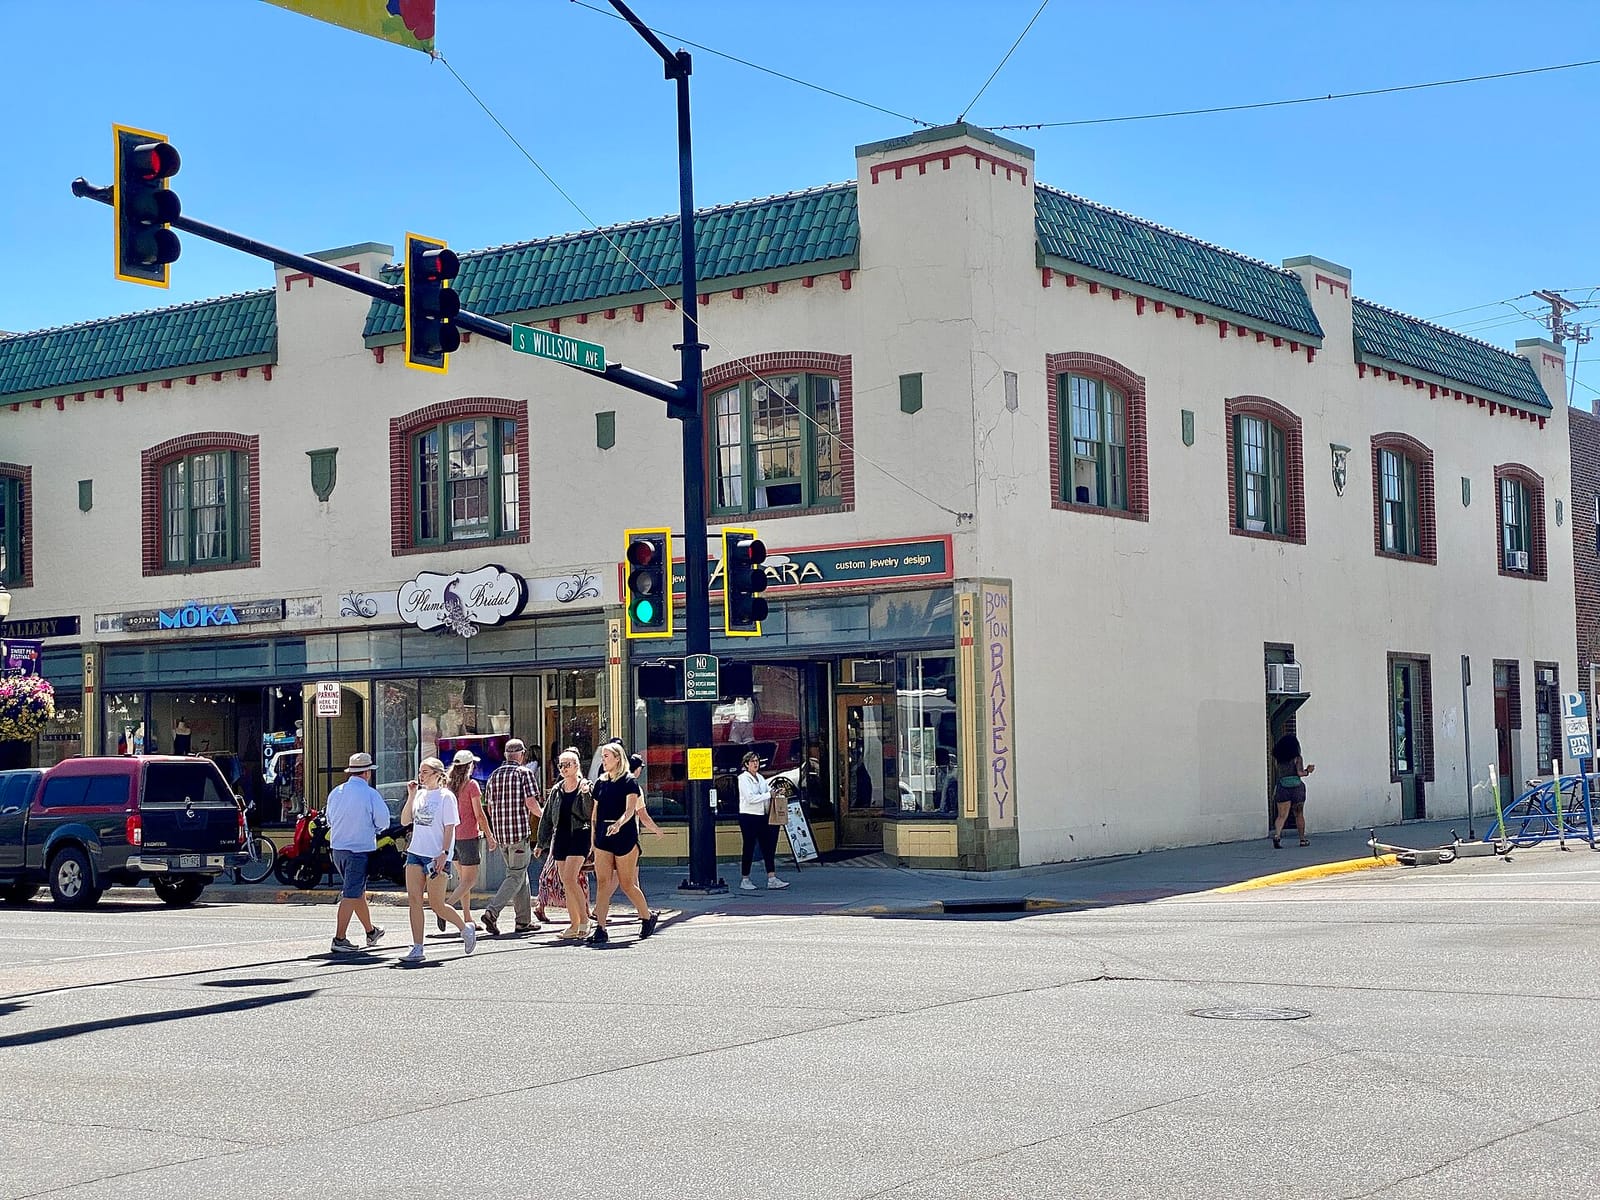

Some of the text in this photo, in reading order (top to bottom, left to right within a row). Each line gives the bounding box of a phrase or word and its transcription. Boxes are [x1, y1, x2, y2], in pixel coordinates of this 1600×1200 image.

[520, 333, 598, 367] S WILLSON AVE
[835, 561, 866, 570] custom
[870, 557, 899, 569] jewelry
[903, 555, 931, 566] design
[405, 582, 515, 612] Plume Bridal
[985, 592, 1008, 618] BON
[985, 616, 1008, 639] TON
[696, 657, 707, 668] NO
[318, 691, 339, 699] PARKING
[1561, 692, 1582, 717] P
[990, 643, 1009, 819] BAKERY
